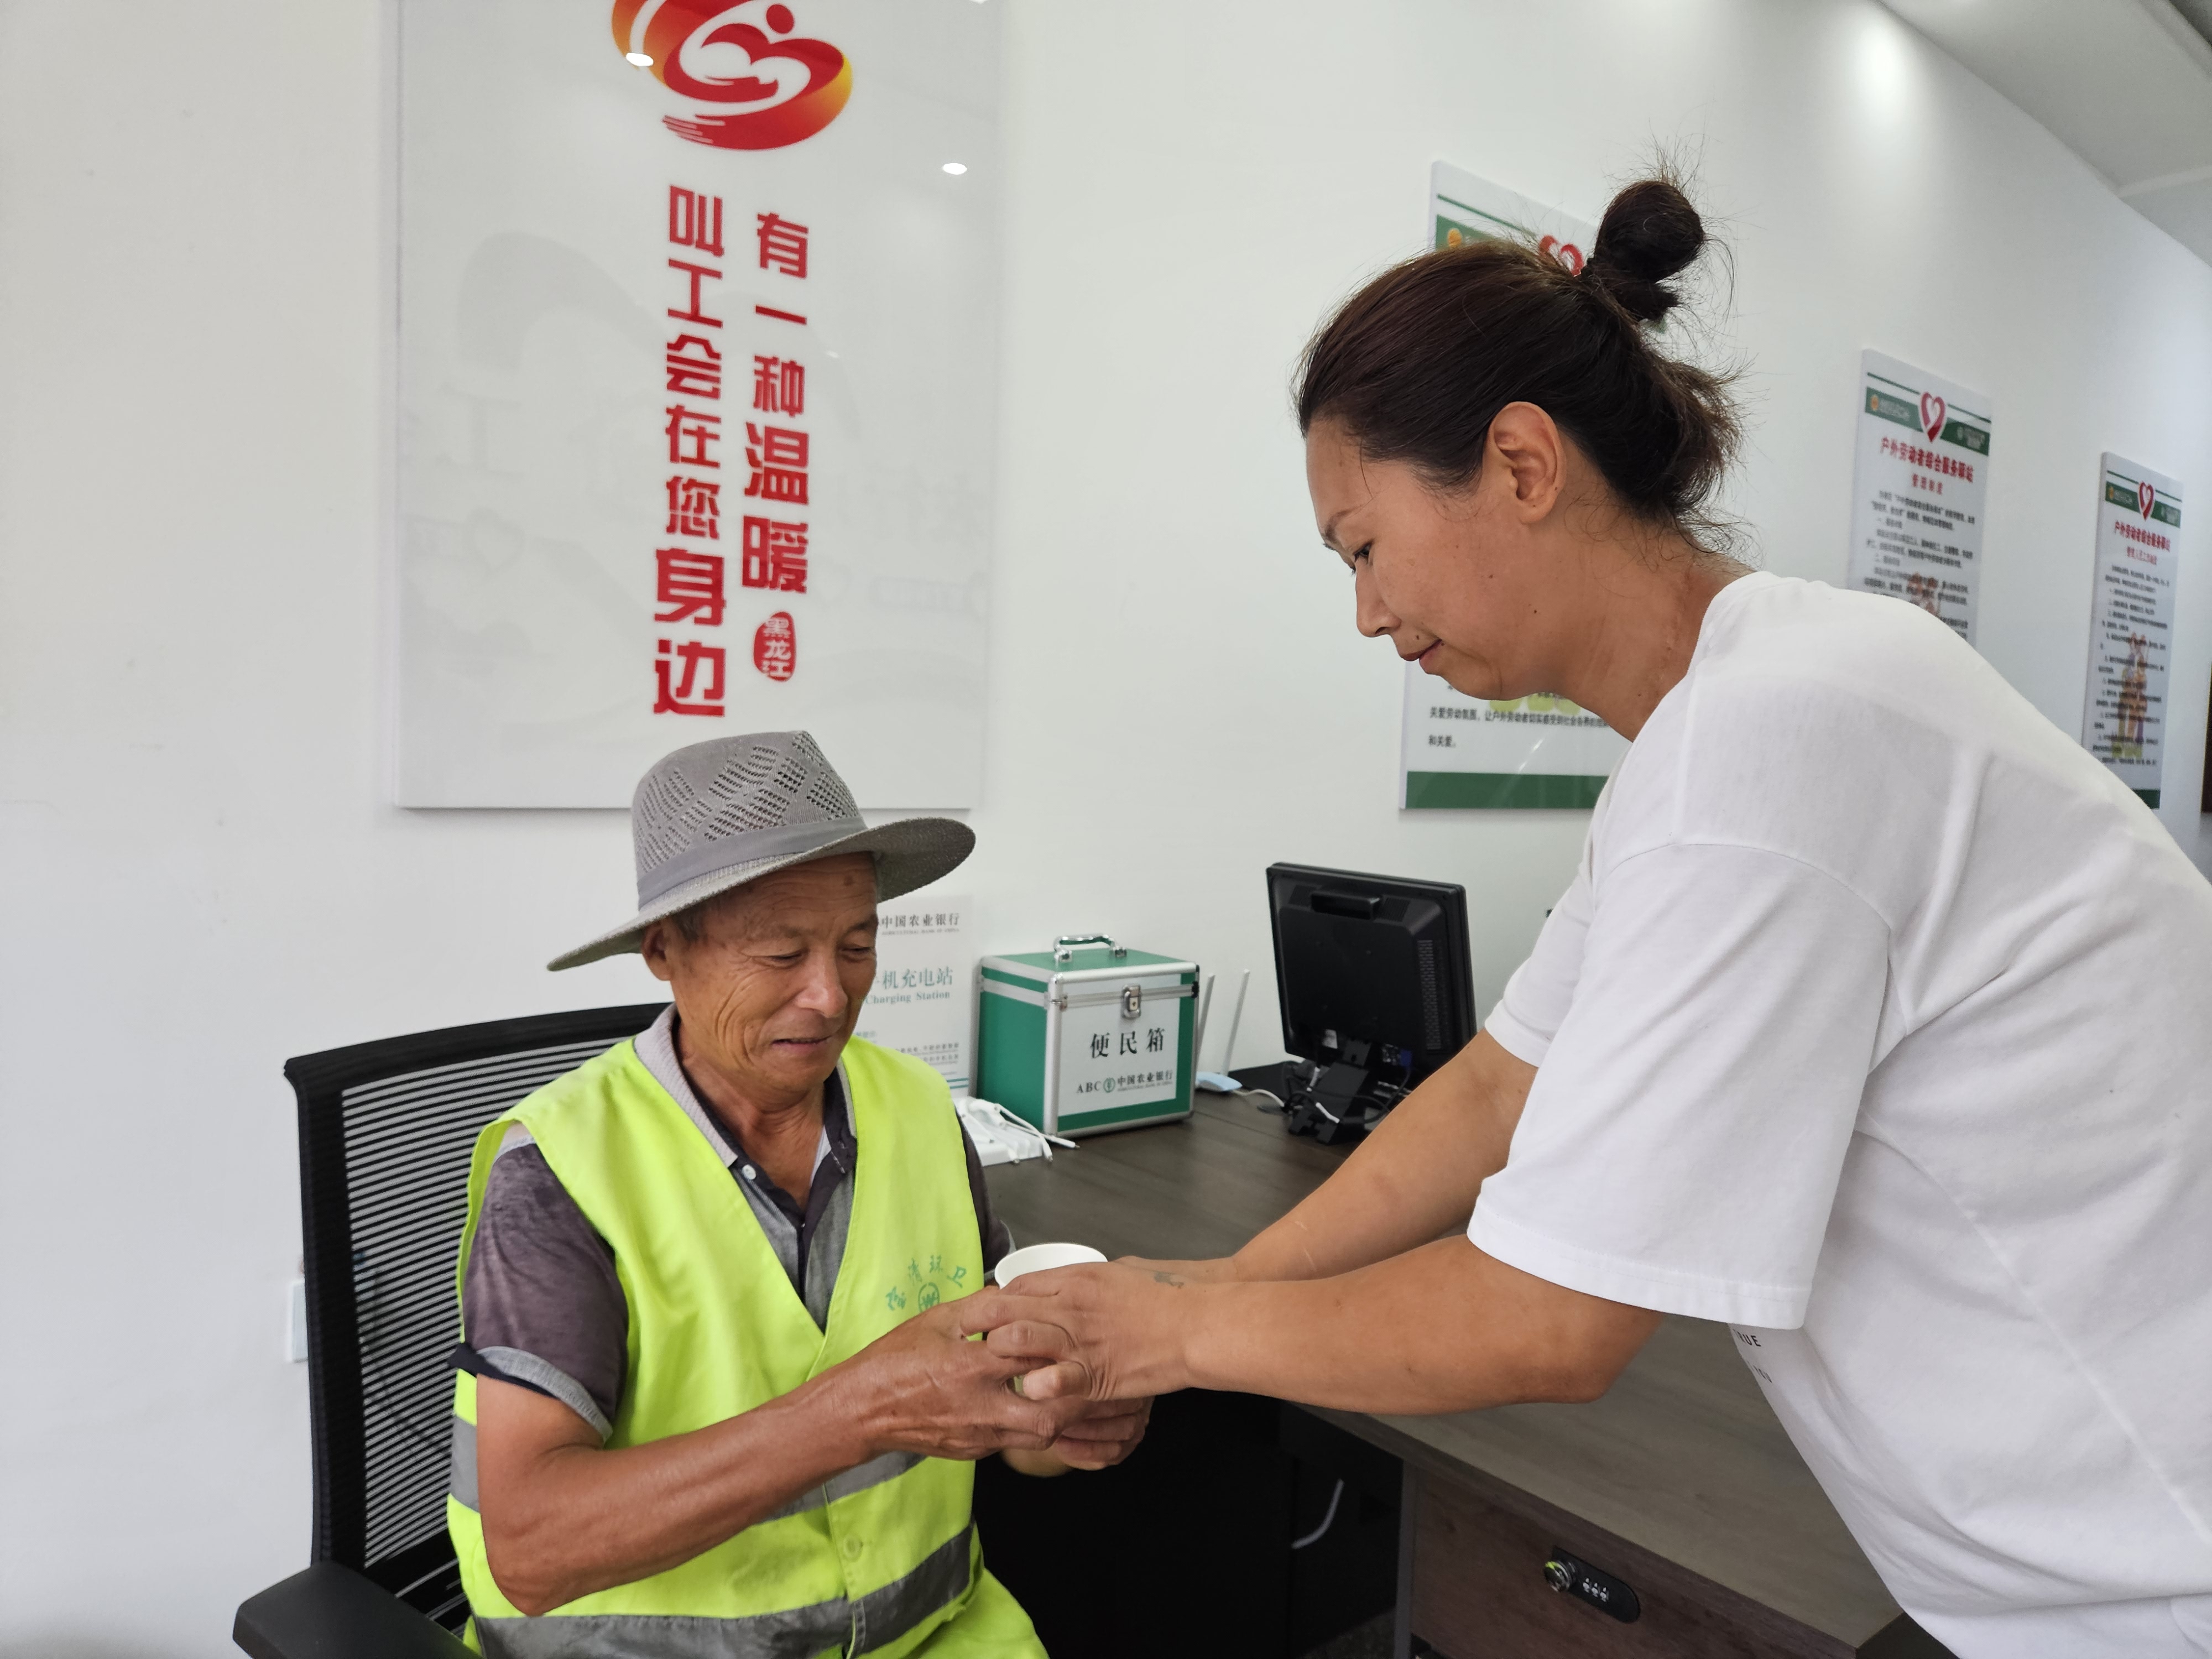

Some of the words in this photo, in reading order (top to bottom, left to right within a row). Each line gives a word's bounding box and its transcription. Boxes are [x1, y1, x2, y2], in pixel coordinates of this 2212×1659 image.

[742, 212, 809, 594] 有一种温暖
[653, 184, 726, 717] 叫工会在您身边
[762, 617, 792, 677] 黑龙江
[881, 912, 960, 929] 中国农业银行
[877, 966, 954, 990] 机充电站
[916, 990, 951, 1001] Station
[1089, 1027, 1166, 1060] 便民箱
[1076, 1081, 1102, 1094] ABC
[1117, 1069, 1173, 1087] 中国农业银行
